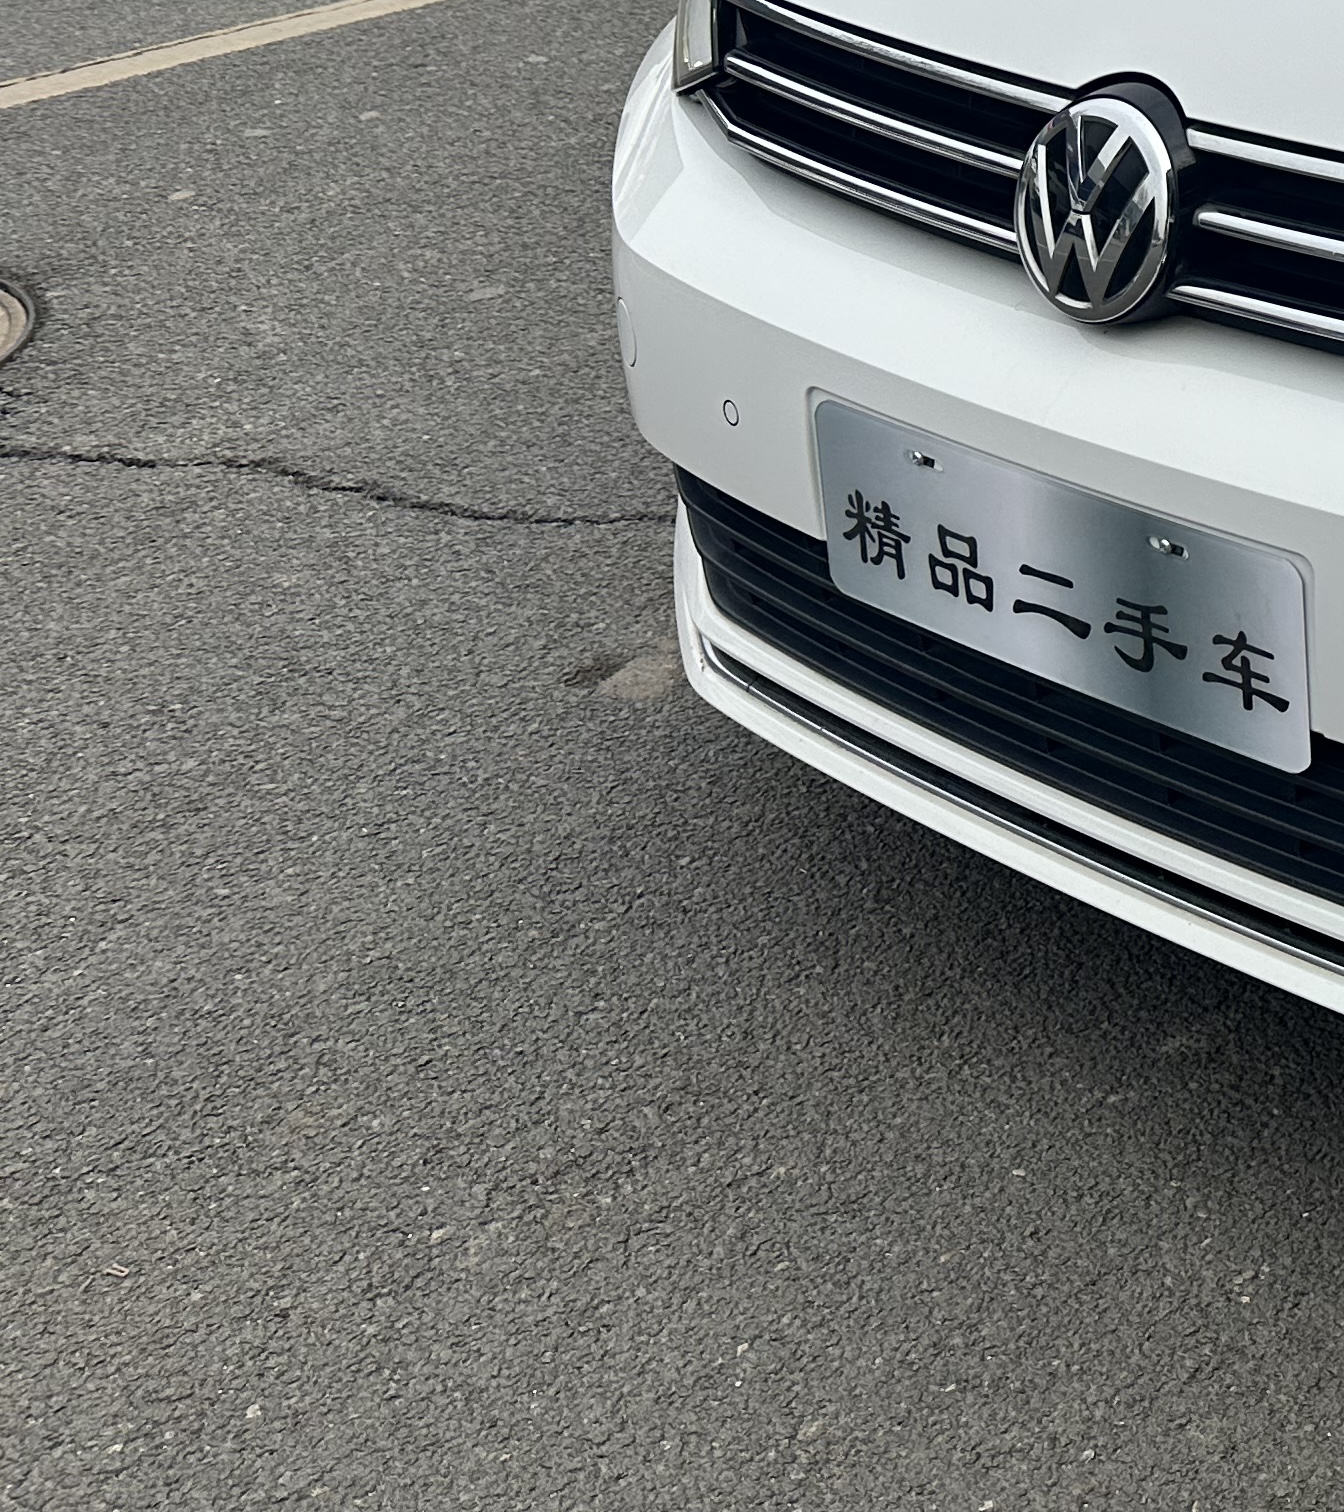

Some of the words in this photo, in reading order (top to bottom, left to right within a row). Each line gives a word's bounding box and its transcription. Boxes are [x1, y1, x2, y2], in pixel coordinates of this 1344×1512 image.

[842, 489, 1291, 714] 精品二手车
